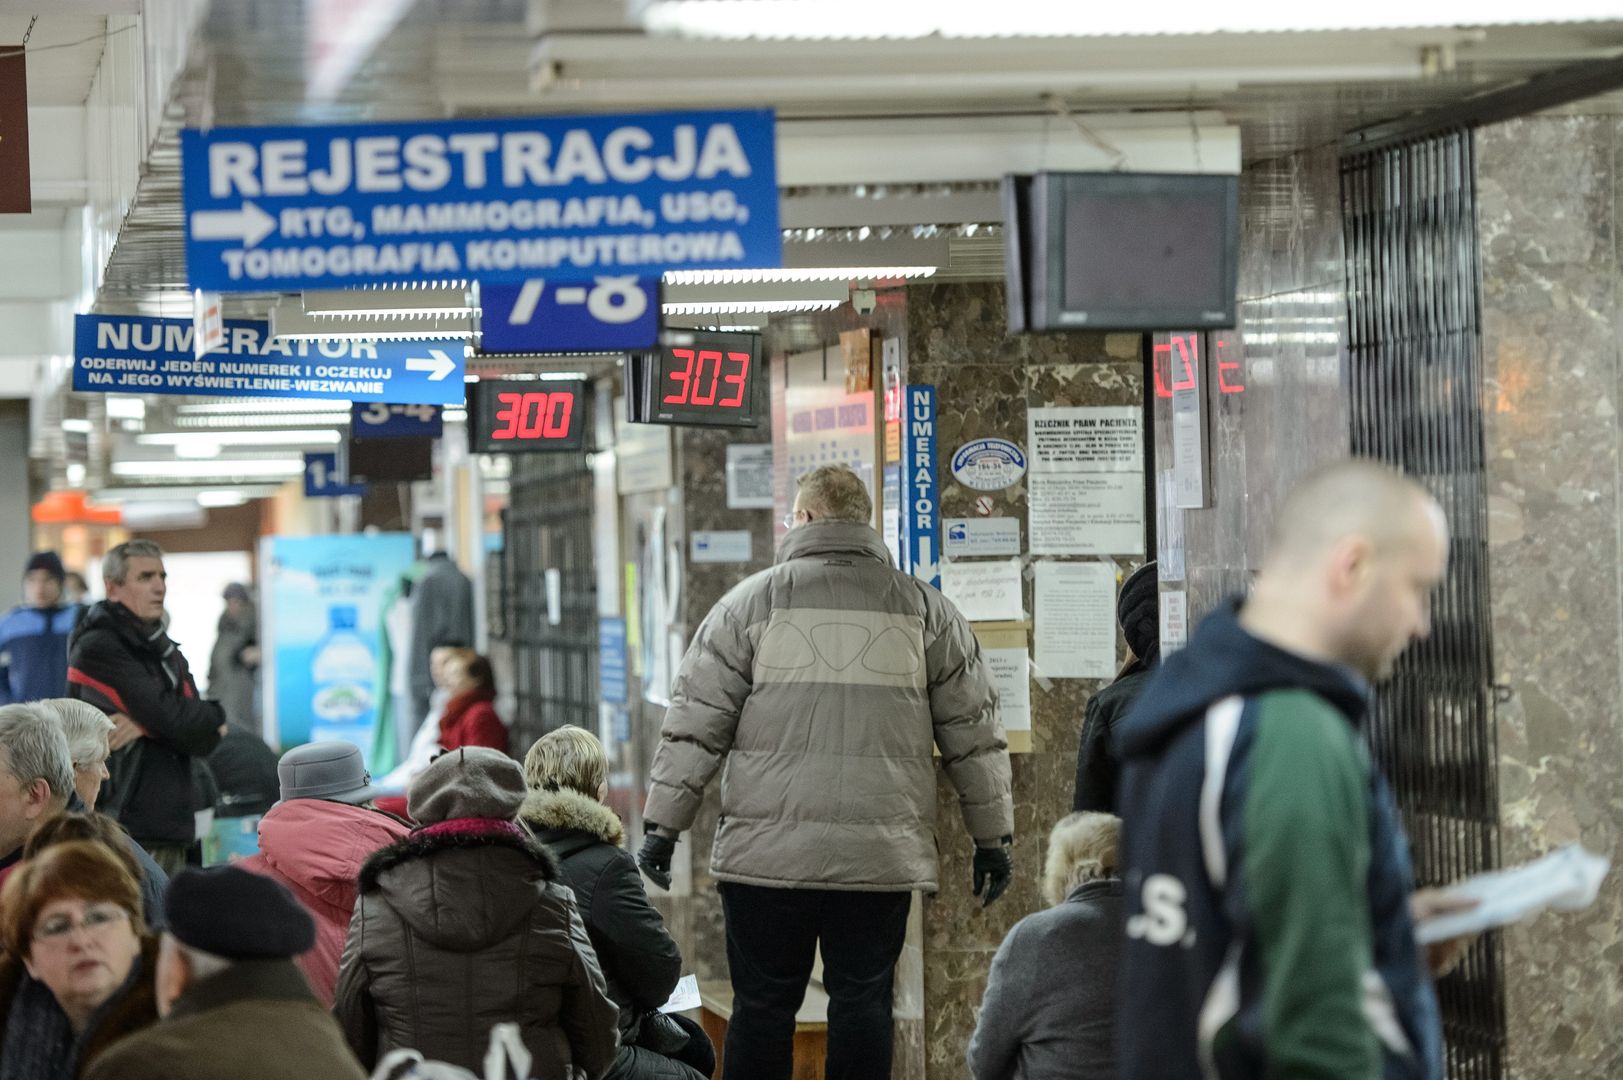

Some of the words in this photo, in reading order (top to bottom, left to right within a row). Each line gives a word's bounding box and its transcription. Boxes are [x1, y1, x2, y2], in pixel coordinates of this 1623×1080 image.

[208, 123, 752, 198] REJESTRACJA
[280, 205, 366, 241] RTG,
[371, 194, 656, 236] MAMMOGRAFIA,
[660, 189, 749, 235] USG,
[221, 241, 461, 280] TOMOGRAFIA
[465, 230, 745, 271] KOMPUTEROWA
[80, 356, 156, 372] ODERWIJ
[160, 359, 215, 374] JEDEN
[219, 362, 301, 376] NUMEREK
[305, 366, 311, 377] I
[315, 366, 393, 380] OCZEKUJ
[88, 372, 114, 385] NA
[118, 373, 163, 387] JEGO
[167, 374, 384, 394] WYŚWIETLENIE-WEZWANIE
[663, 348, 751, 408] 303
[491, 392, 574, 440] 300
[1034, 419, 1070, 428] RZECZNIK
[1073, 419, 1097, 428] PRAW
[1100, 419, 1137, 428] PACJENTA
[912, 390, 933, 530] NUMERATOR
